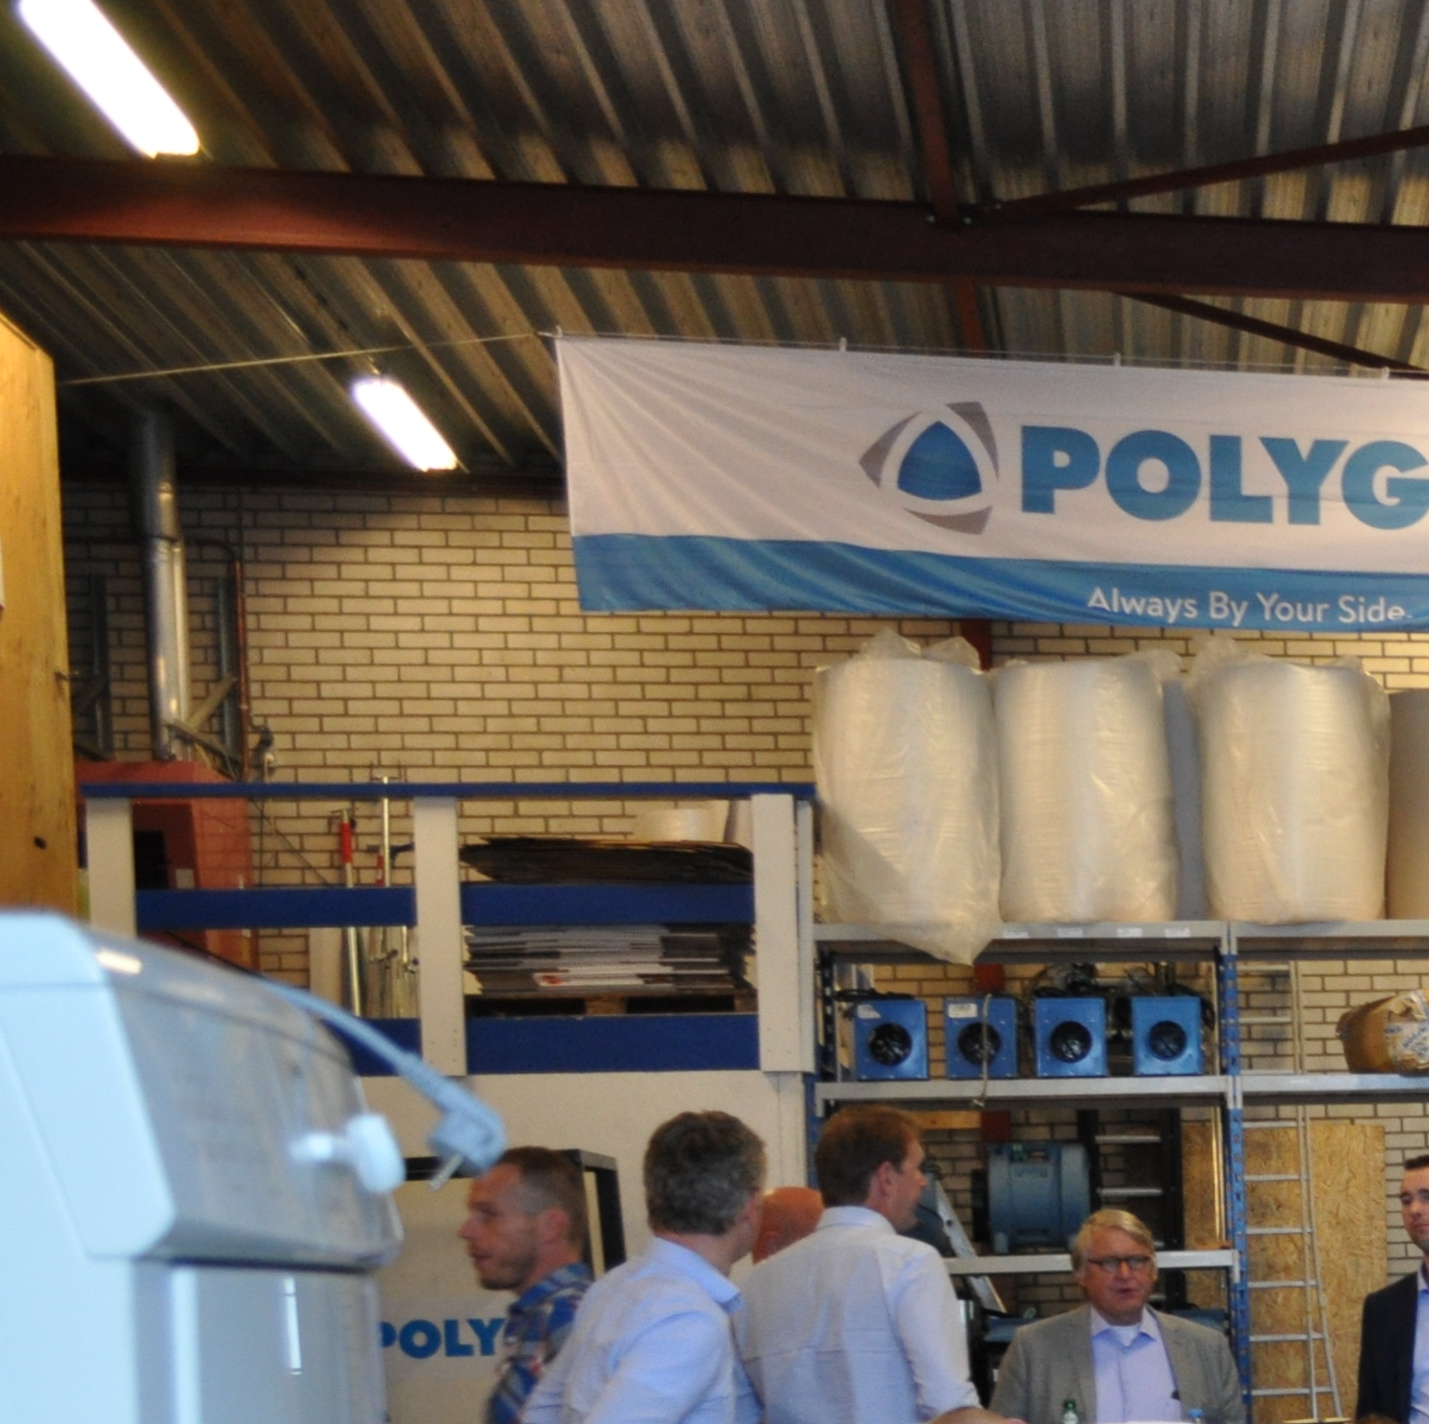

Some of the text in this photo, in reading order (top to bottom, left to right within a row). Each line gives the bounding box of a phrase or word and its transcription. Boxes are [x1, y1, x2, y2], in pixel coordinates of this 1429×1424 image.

[1087, 587, 1198, 623] Always
[1209, 591, 1248, 627] By
[1256, 593, 1329, 622] Your
